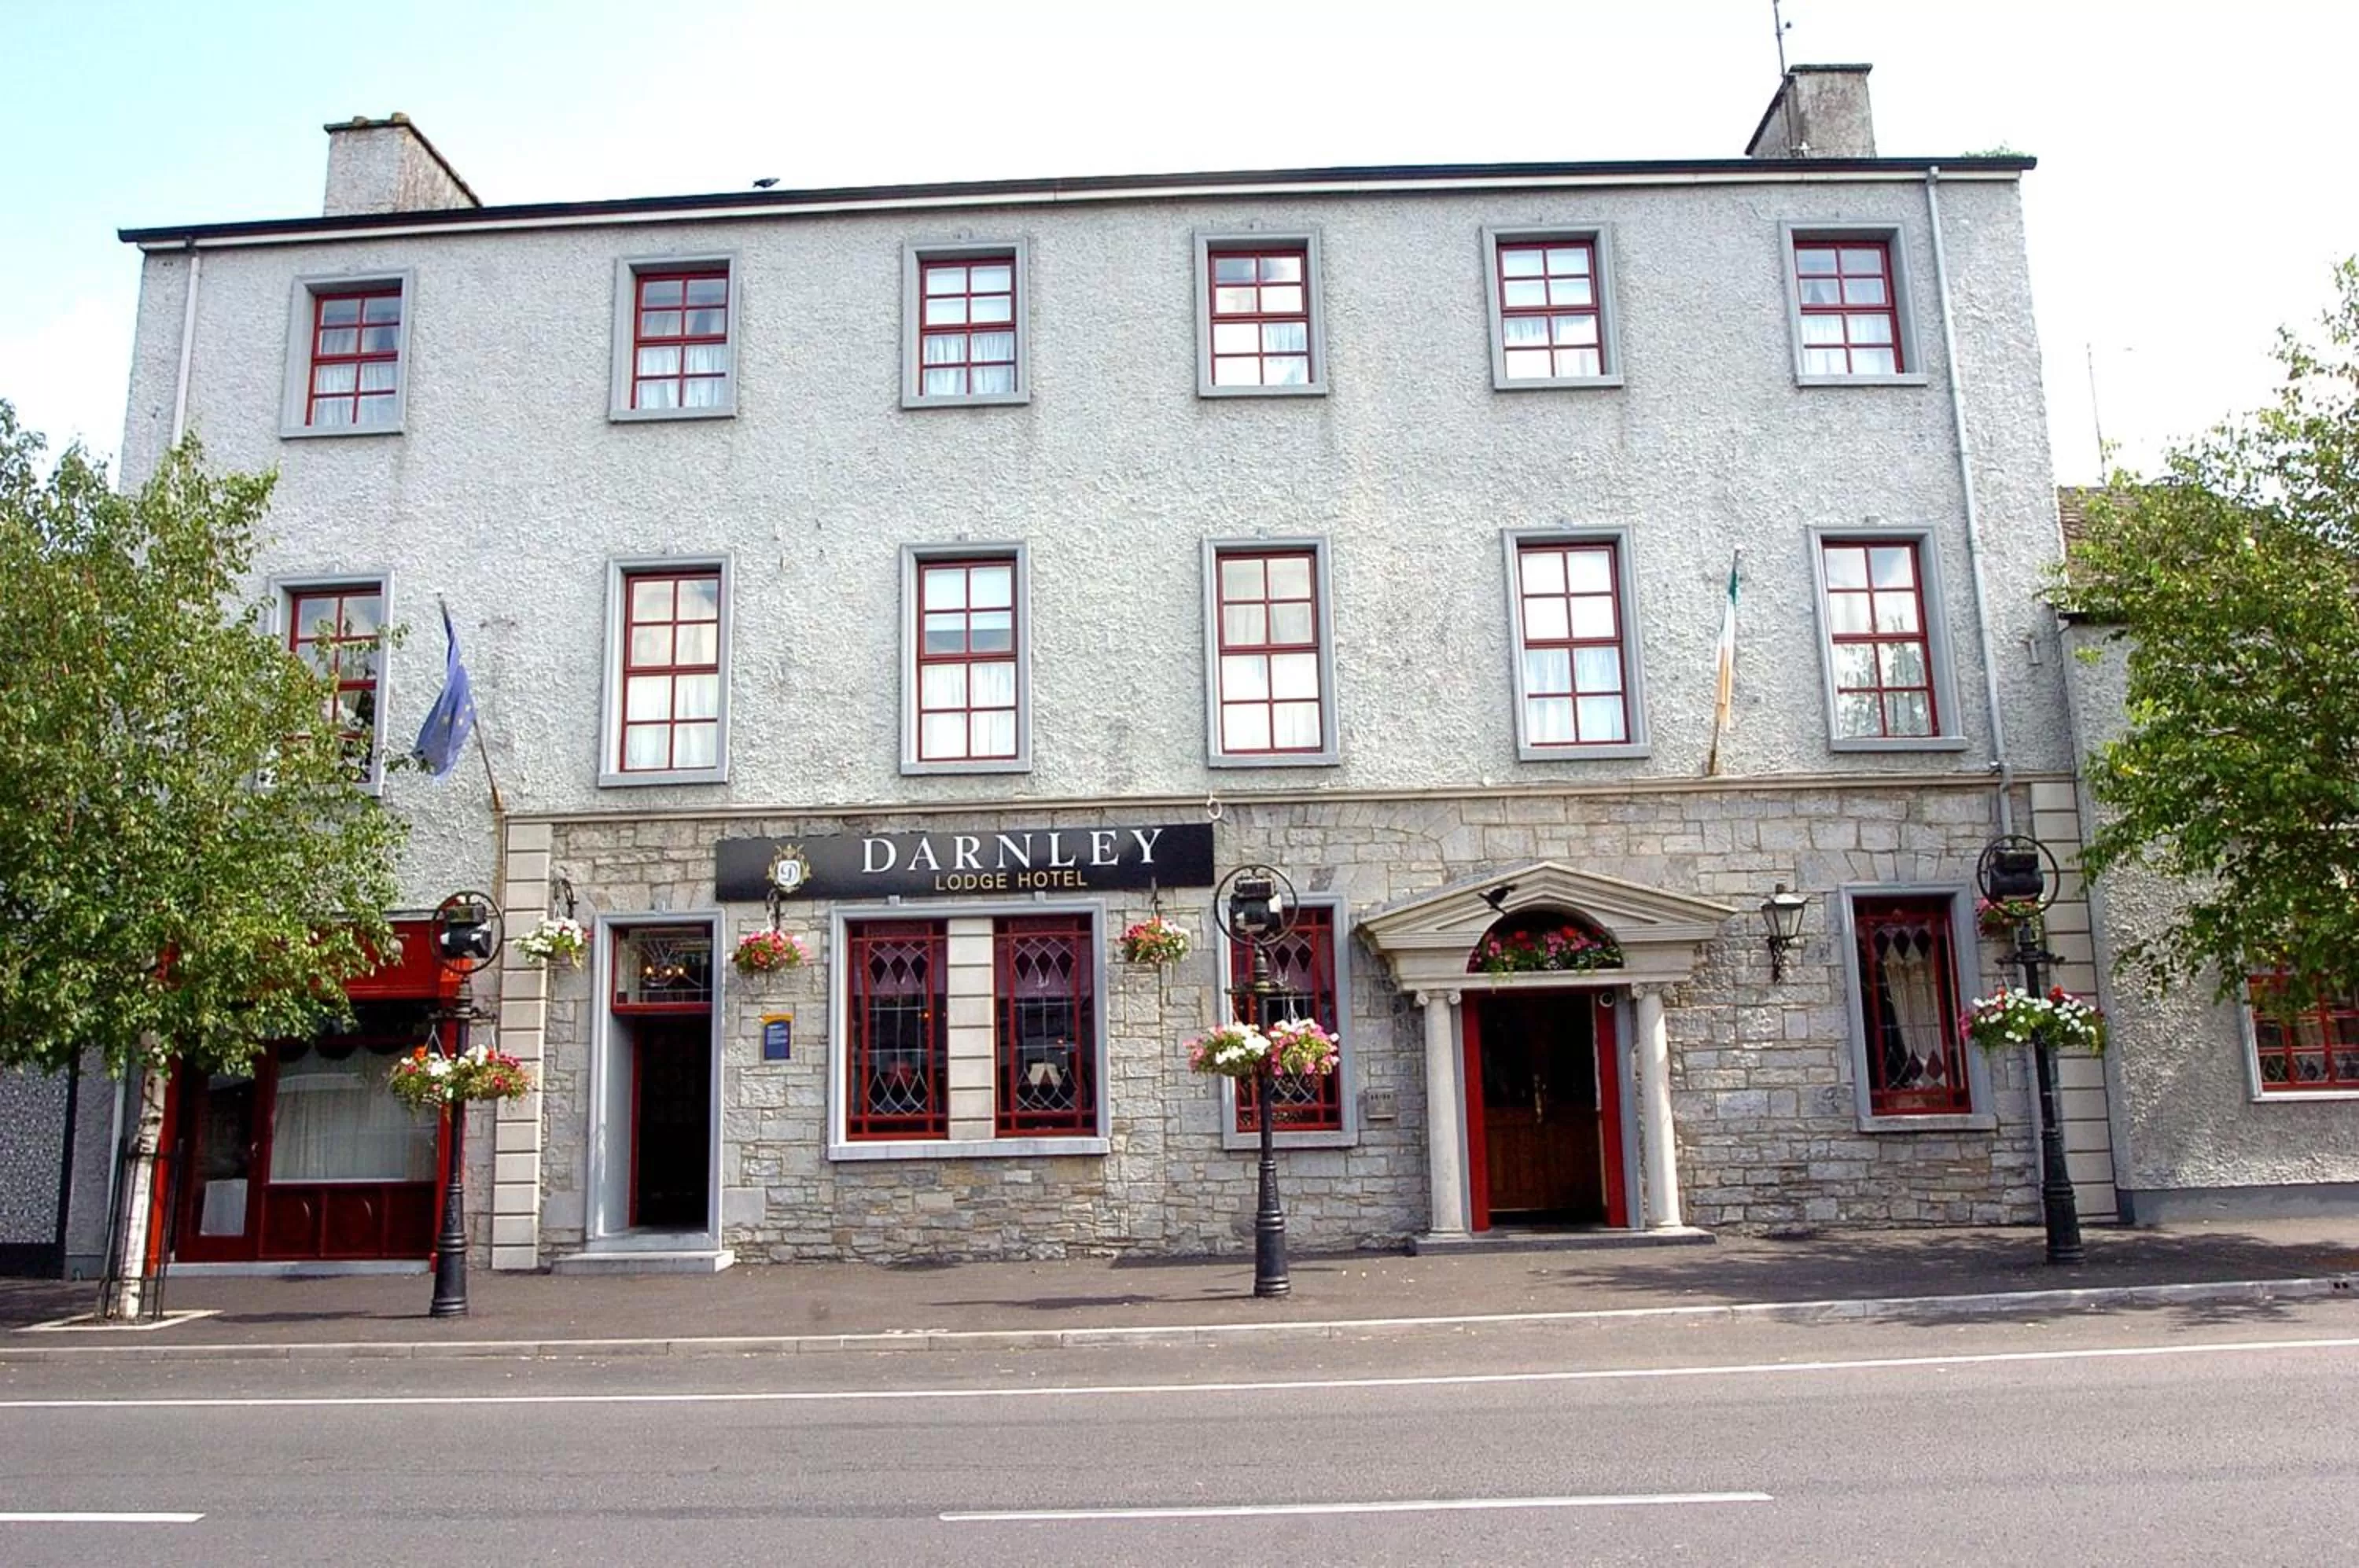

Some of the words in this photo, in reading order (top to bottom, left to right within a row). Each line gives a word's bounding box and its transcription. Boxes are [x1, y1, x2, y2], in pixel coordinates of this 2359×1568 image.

[861, 828, 1163, 873] DARNLEY
[935, 872, 1007, 891] LODGE
[1018, 870, 1088, 889] HOTEL
